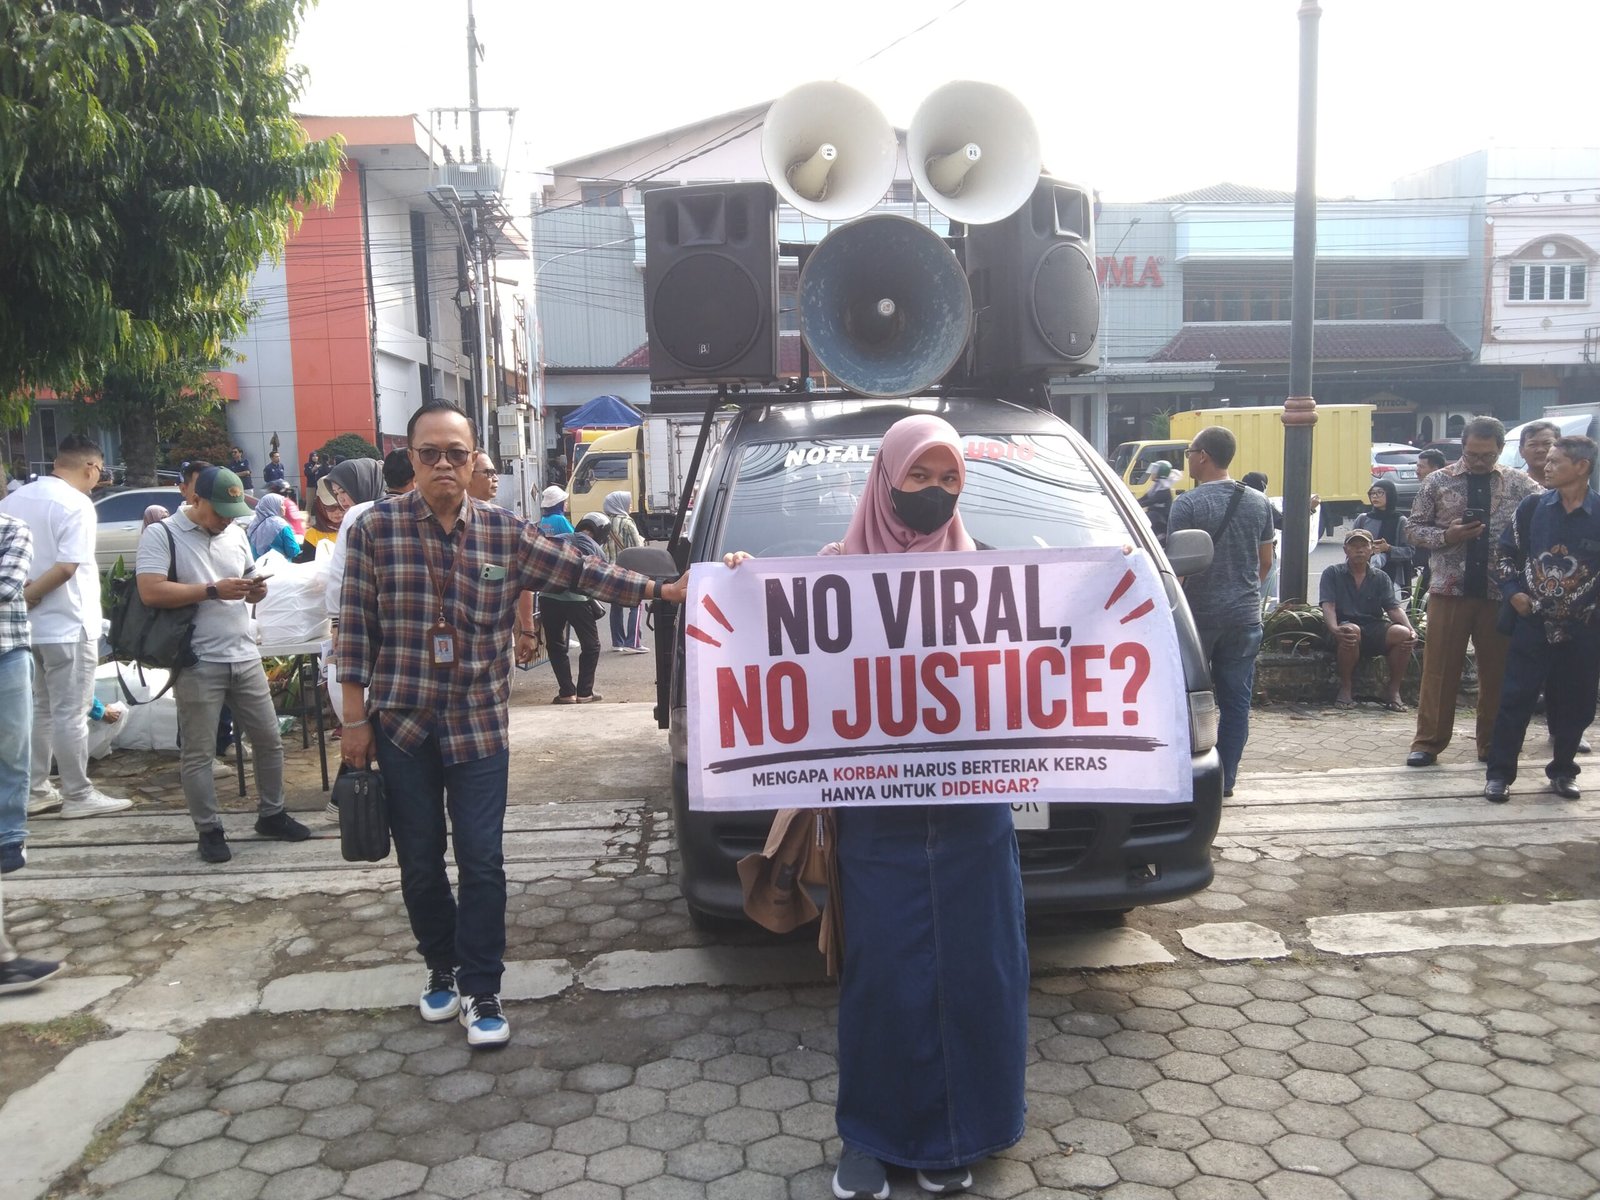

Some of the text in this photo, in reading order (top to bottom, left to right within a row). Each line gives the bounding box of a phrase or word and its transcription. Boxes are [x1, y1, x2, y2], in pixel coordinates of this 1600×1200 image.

[784, 444, 875, 467] NOFAL
[765, 565, 1072, 656] NO VIRAL,
[717, 642, 1151, 749] NO JUSTICE?
[752, 756, 1108, 787] MENGAPA KORBAN HARUS BERTERIAK KERAS
[821, 777, 1040, 803] HANYA UNTUK DIDENGAR?
